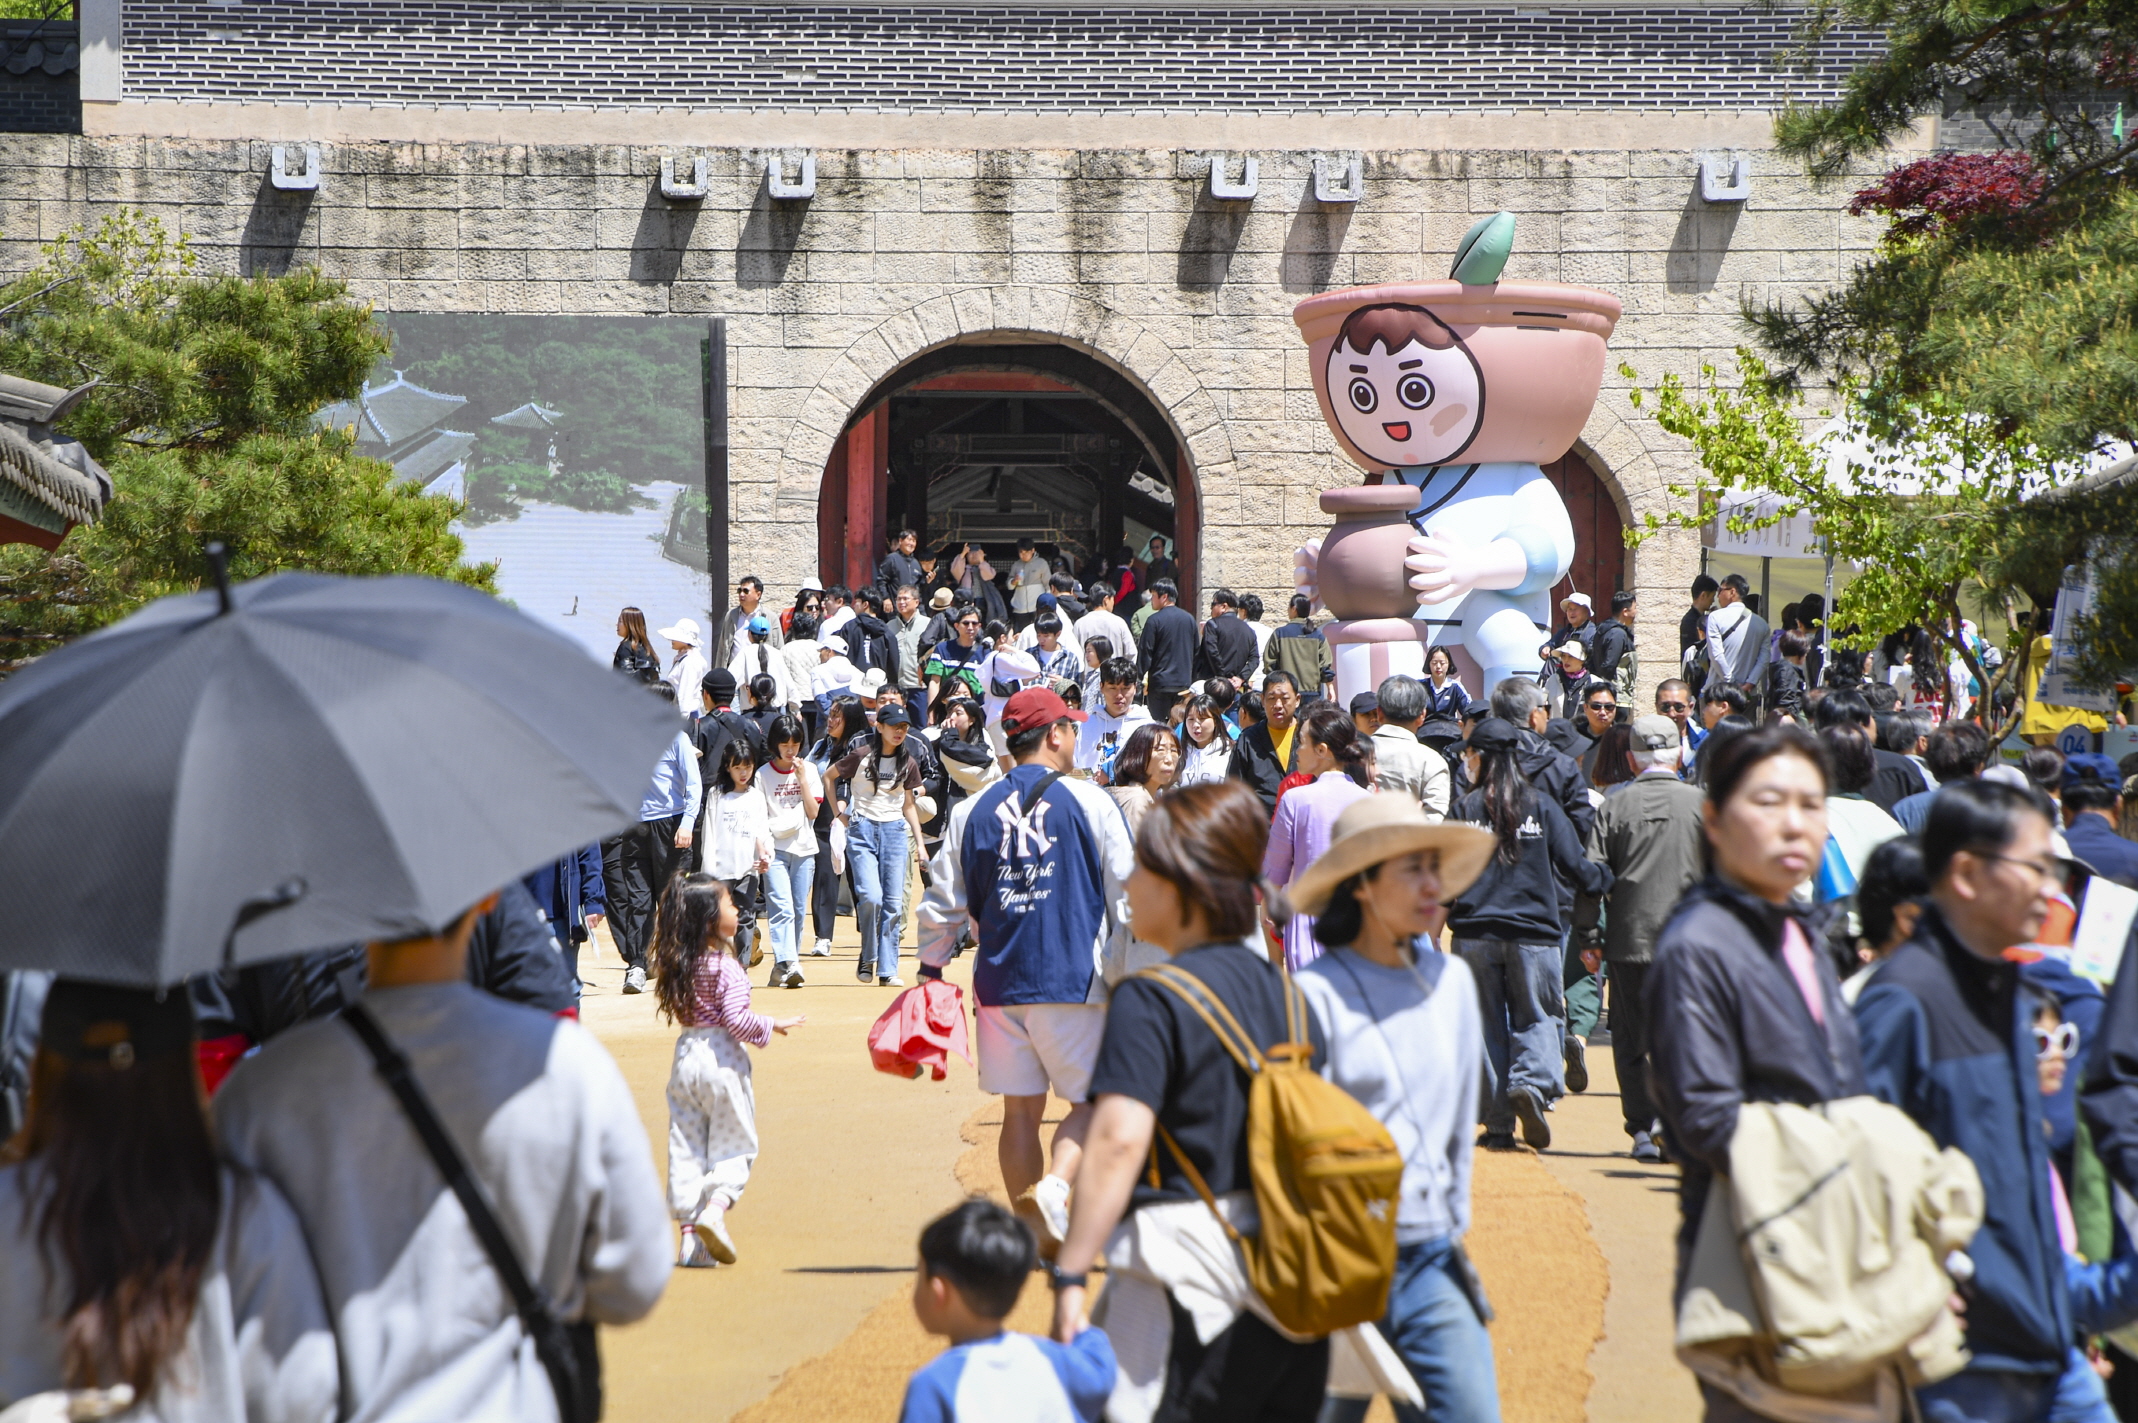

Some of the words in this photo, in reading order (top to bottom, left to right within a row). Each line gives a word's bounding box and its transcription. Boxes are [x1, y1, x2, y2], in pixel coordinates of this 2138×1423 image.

[2064, 735, 2086, 754] 04
[998, 864, 1024, 881] New
[1023, 861, 1056, 887] York
[999, 885, 1052, 911] Yankees
